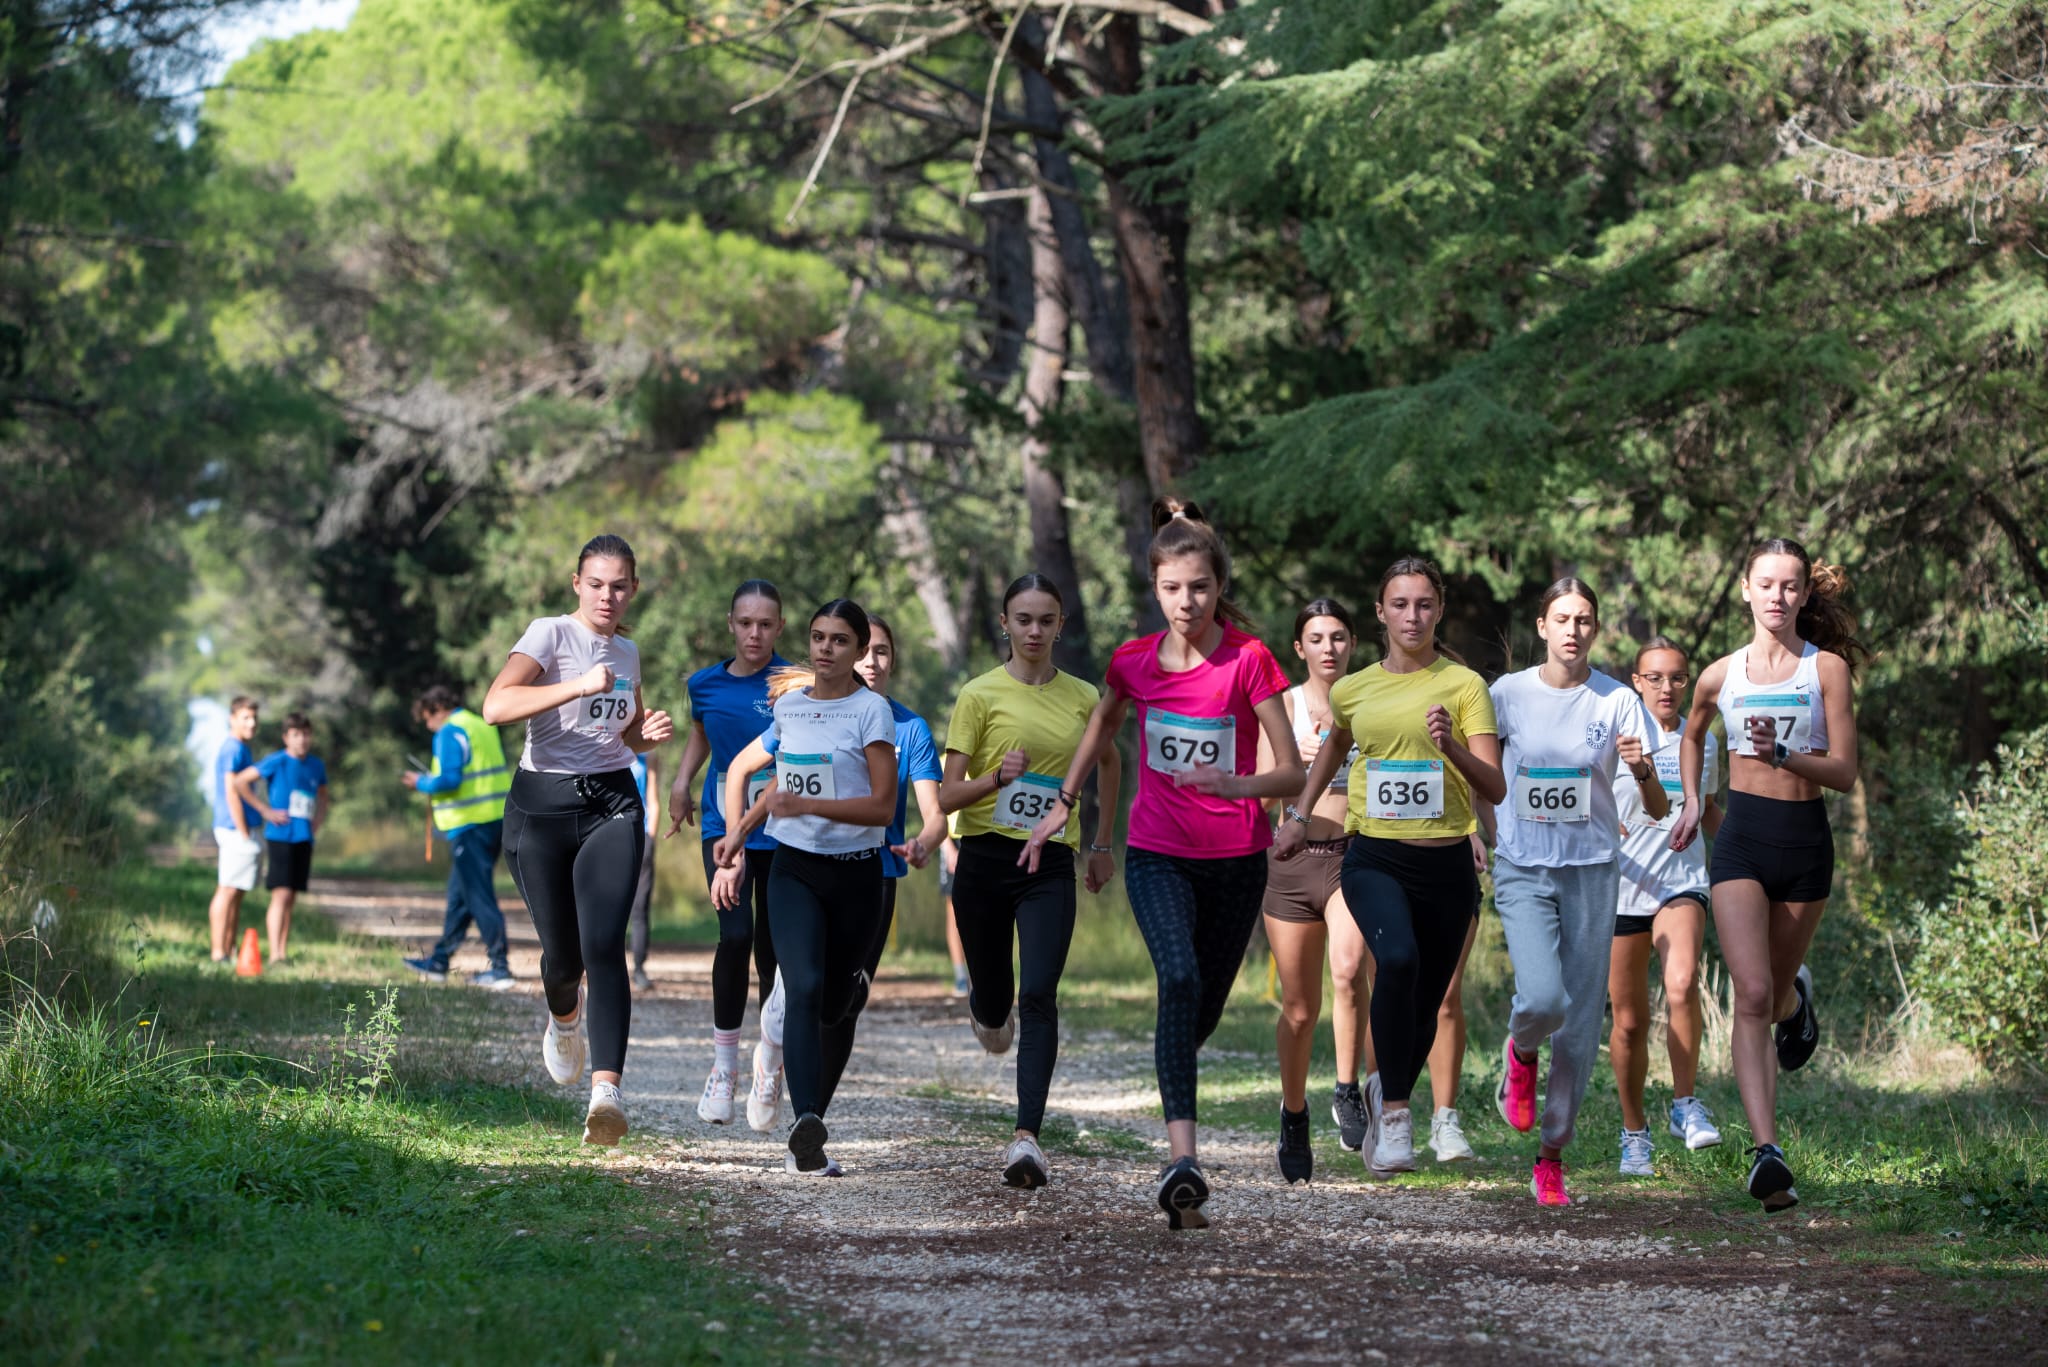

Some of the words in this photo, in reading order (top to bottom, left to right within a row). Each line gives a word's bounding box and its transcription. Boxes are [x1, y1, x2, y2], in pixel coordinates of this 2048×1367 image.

[589, 697, 628, 720] 678
[1160, 735, 1219, 765] 679
[786, 772, 822, 796] 696
[1378, 781, 1429, 805] 636
[1528, 786, 1577, 810] 666
